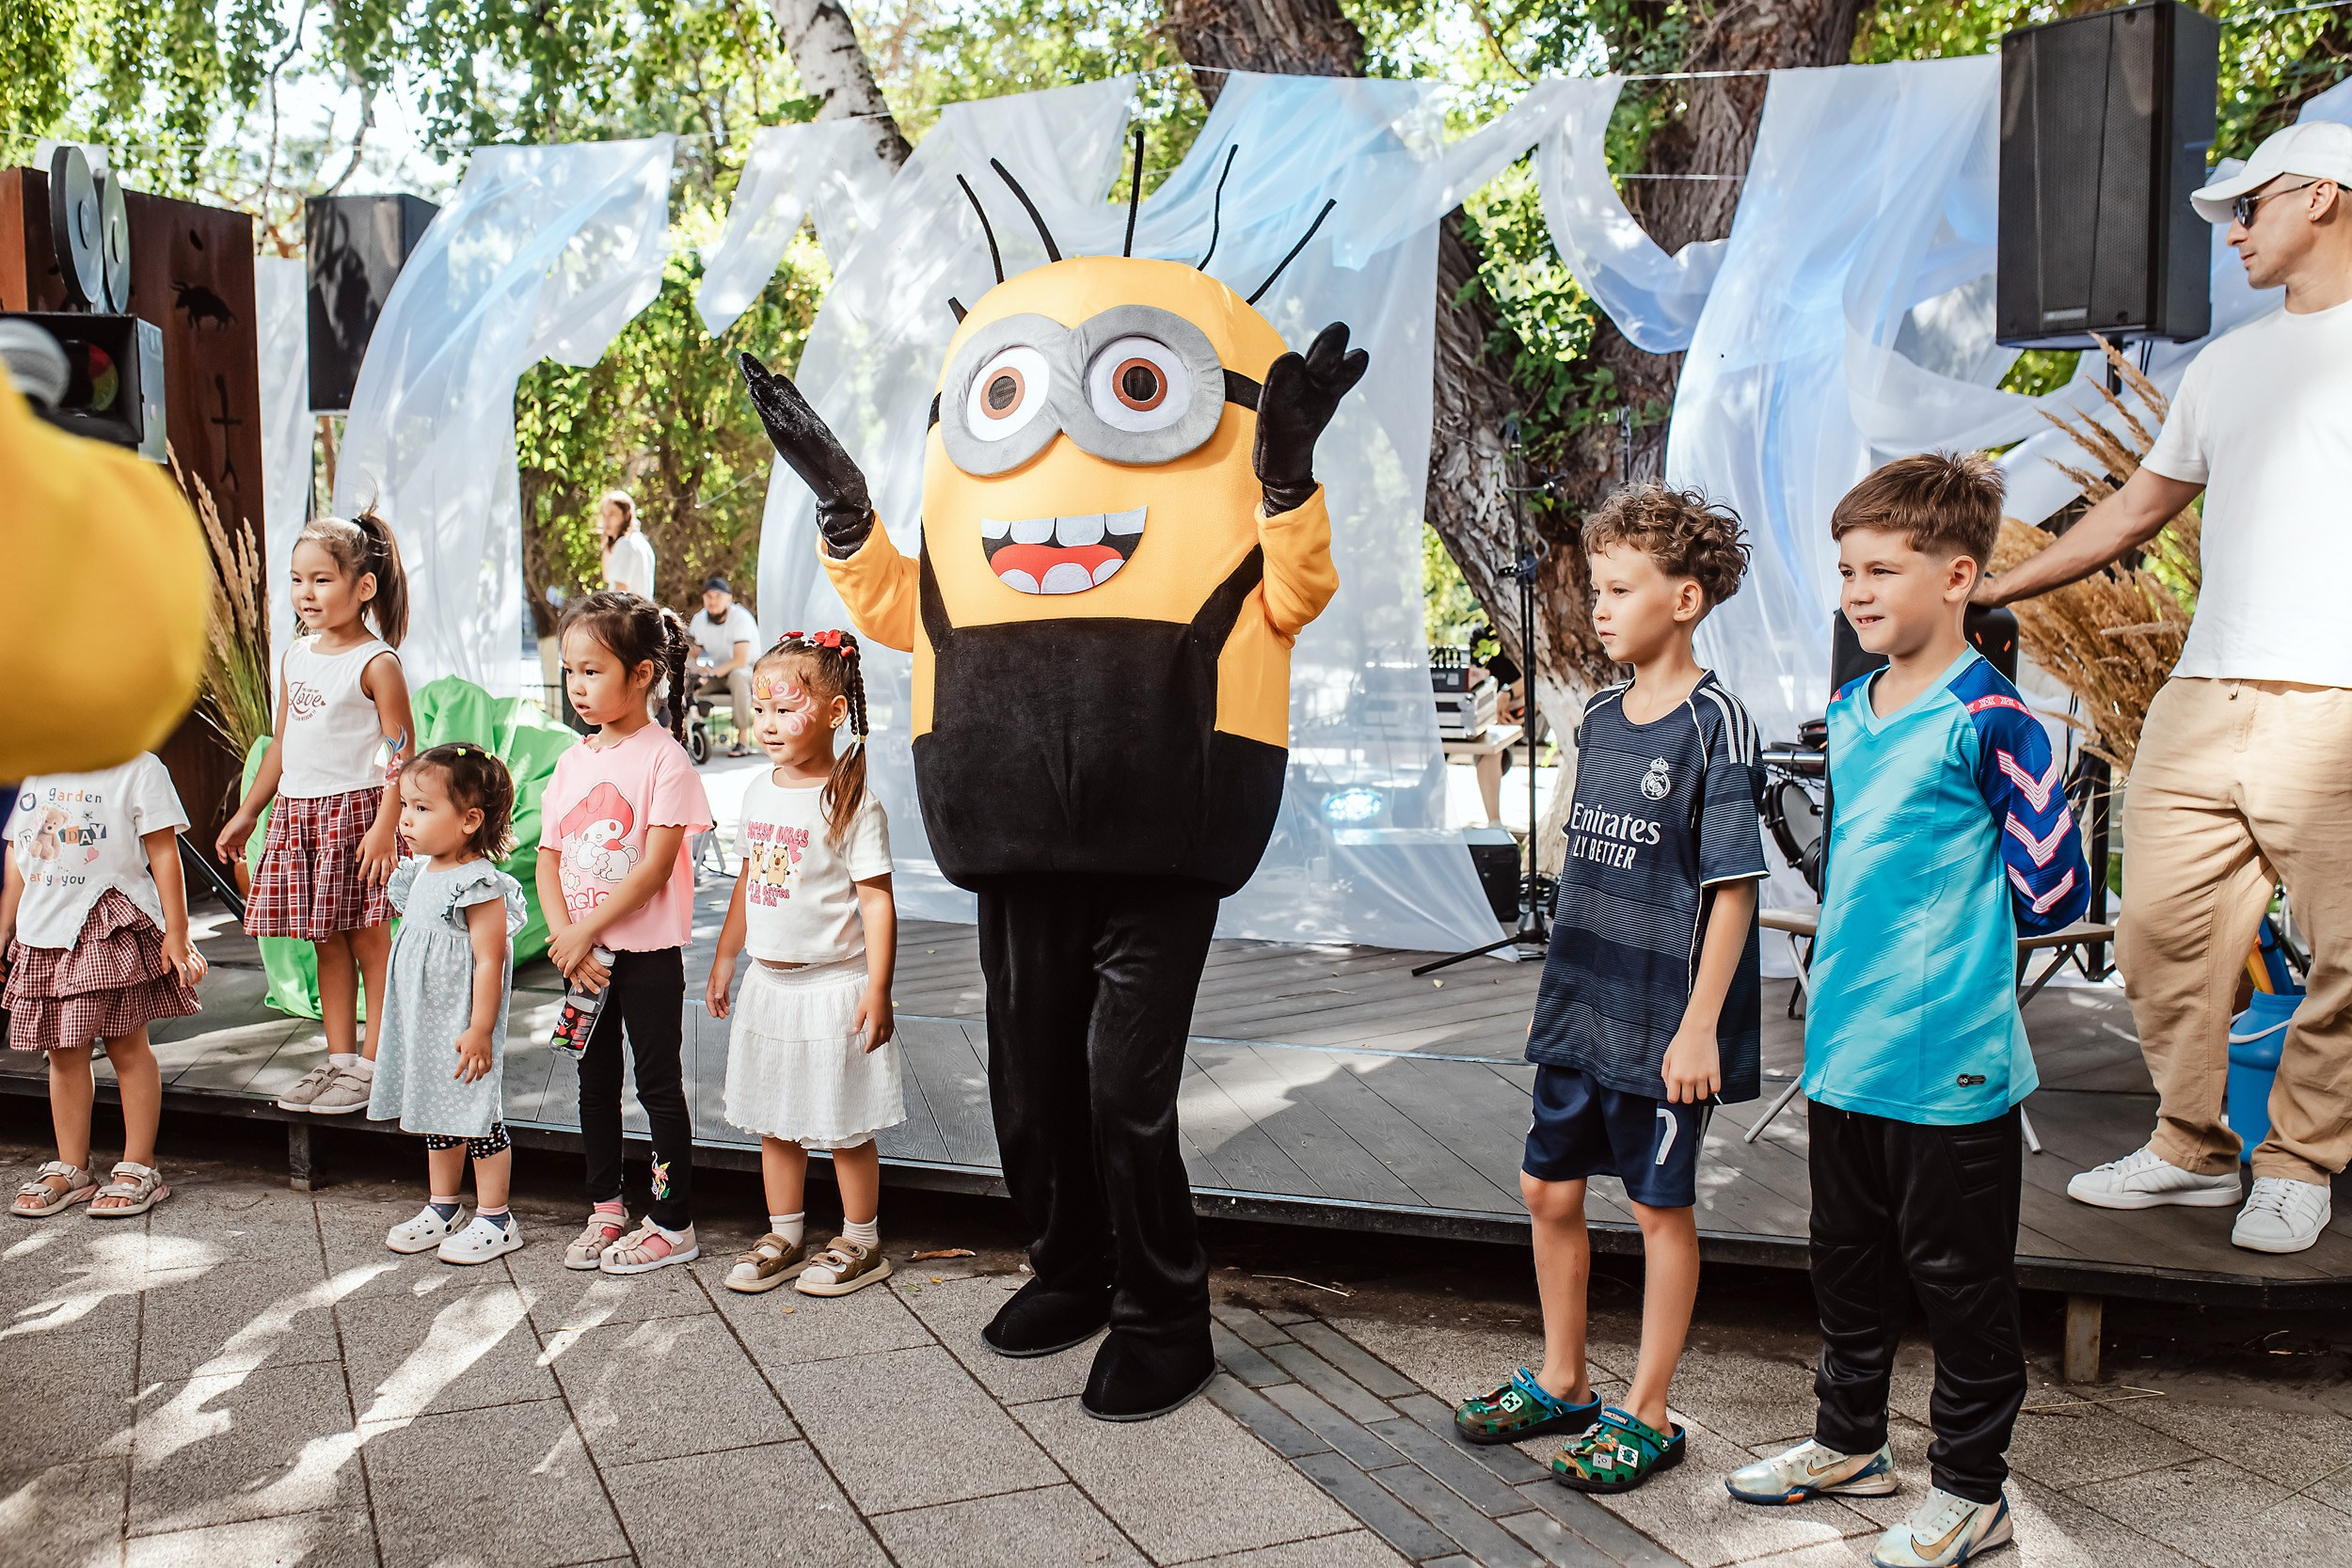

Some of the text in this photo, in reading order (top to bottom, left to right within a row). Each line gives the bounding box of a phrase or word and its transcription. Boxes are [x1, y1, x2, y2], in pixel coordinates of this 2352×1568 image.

[288, 681, 322, 715] Love
[49, 787, 102, 803] garden
[68, 824, 105, 845] DAY
[1570, 835, 1637, 870] LY BETTER
[61, 875, 86, 887] you
